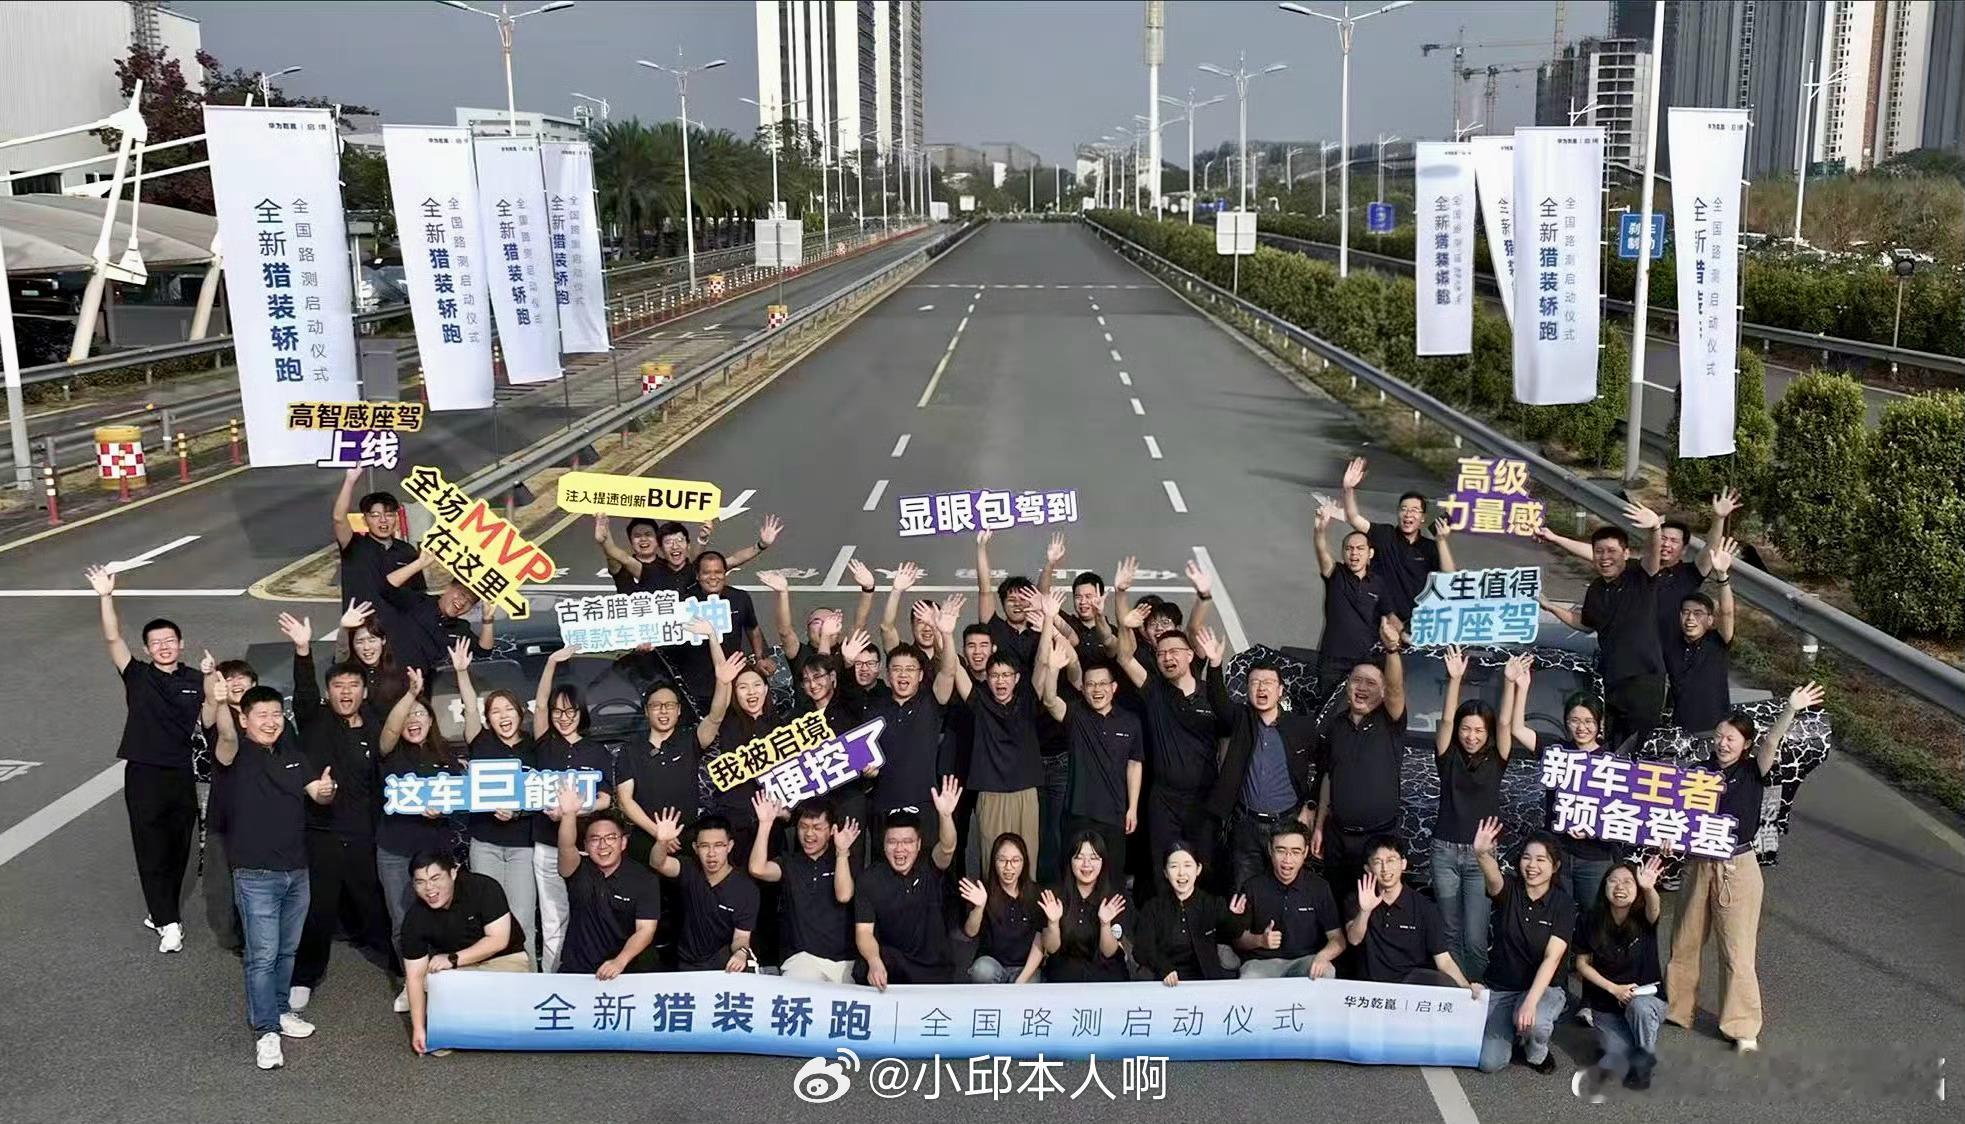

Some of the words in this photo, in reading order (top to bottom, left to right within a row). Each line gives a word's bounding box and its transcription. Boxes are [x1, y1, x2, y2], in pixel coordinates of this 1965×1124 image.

[254, 198, 304, 383] 全新猎装轿跑
[292, 198, 329, 382] 全国路测启动仪式
[421, 197, 463, 344] 全新猎装轿跑
[448, 197, 480, 343] 全国路测启动仪式
[496, 198, 531, 326] 全新猎装轿跑
[1539, 197, 1559, 341] 全新猎装轿跑
[1564, 197, 1576, 341] 全国路测启动仪式
[289, 403, 421, 429] 高智感座驾
[317, 431, 399, 469] 上线
[1457, 456, 1528, 496] 高级
[404, 468, 553, 583] 全场MVP
[565, 488, 713, 511] 注入提速创新BUFF
[899, 490, 1078, 537] 显眼包驾到
[1437, 495, 1544, 536] 力量感
[423, 524, 510, 603] 在这里
[1414, 569, 1539, 602] 人生值得
[558, 593, 676, 624] 古希腊掌管
[1411, 602, 1537, 644] 新座驾
[711, 714, 831, 788] 我被启境
[757, 719, 886, 809] 硬控了
[1540, 747, 1726, 814] 新车王者
[1553, 792, 1738, 858] 预备登基
[533, 992, 872, 1041] 全新猎装轿跑
[920, 1002, 1306, 1039] 全国路测启动仪式
[1344, 995, 1397, 1011] 华为乾崑
[1415, 1000, 1454, 1014] 启境
